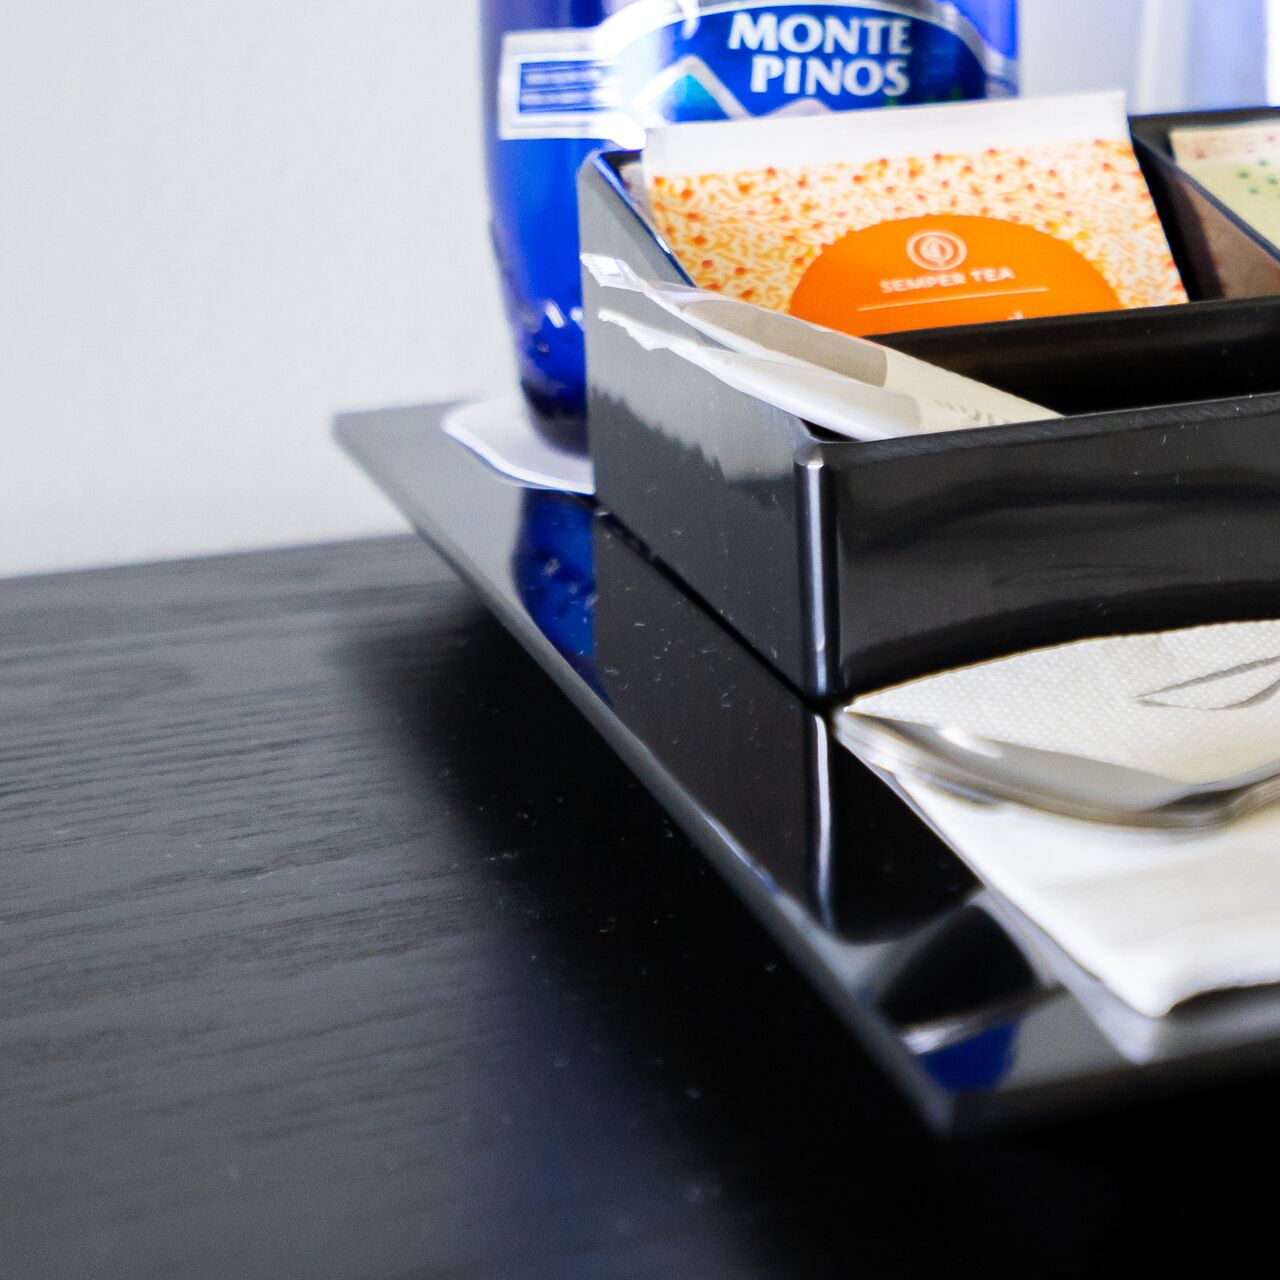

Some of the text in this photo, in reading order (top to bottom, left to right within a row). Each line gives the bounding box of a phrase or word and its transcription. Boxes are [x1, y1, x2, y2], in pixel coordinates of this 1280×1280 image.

[728, 11, 912, 56] MONTE
[751, 53, 910, 97] PINOS
[879, 266, 1016, 294] SEMPER TEA
